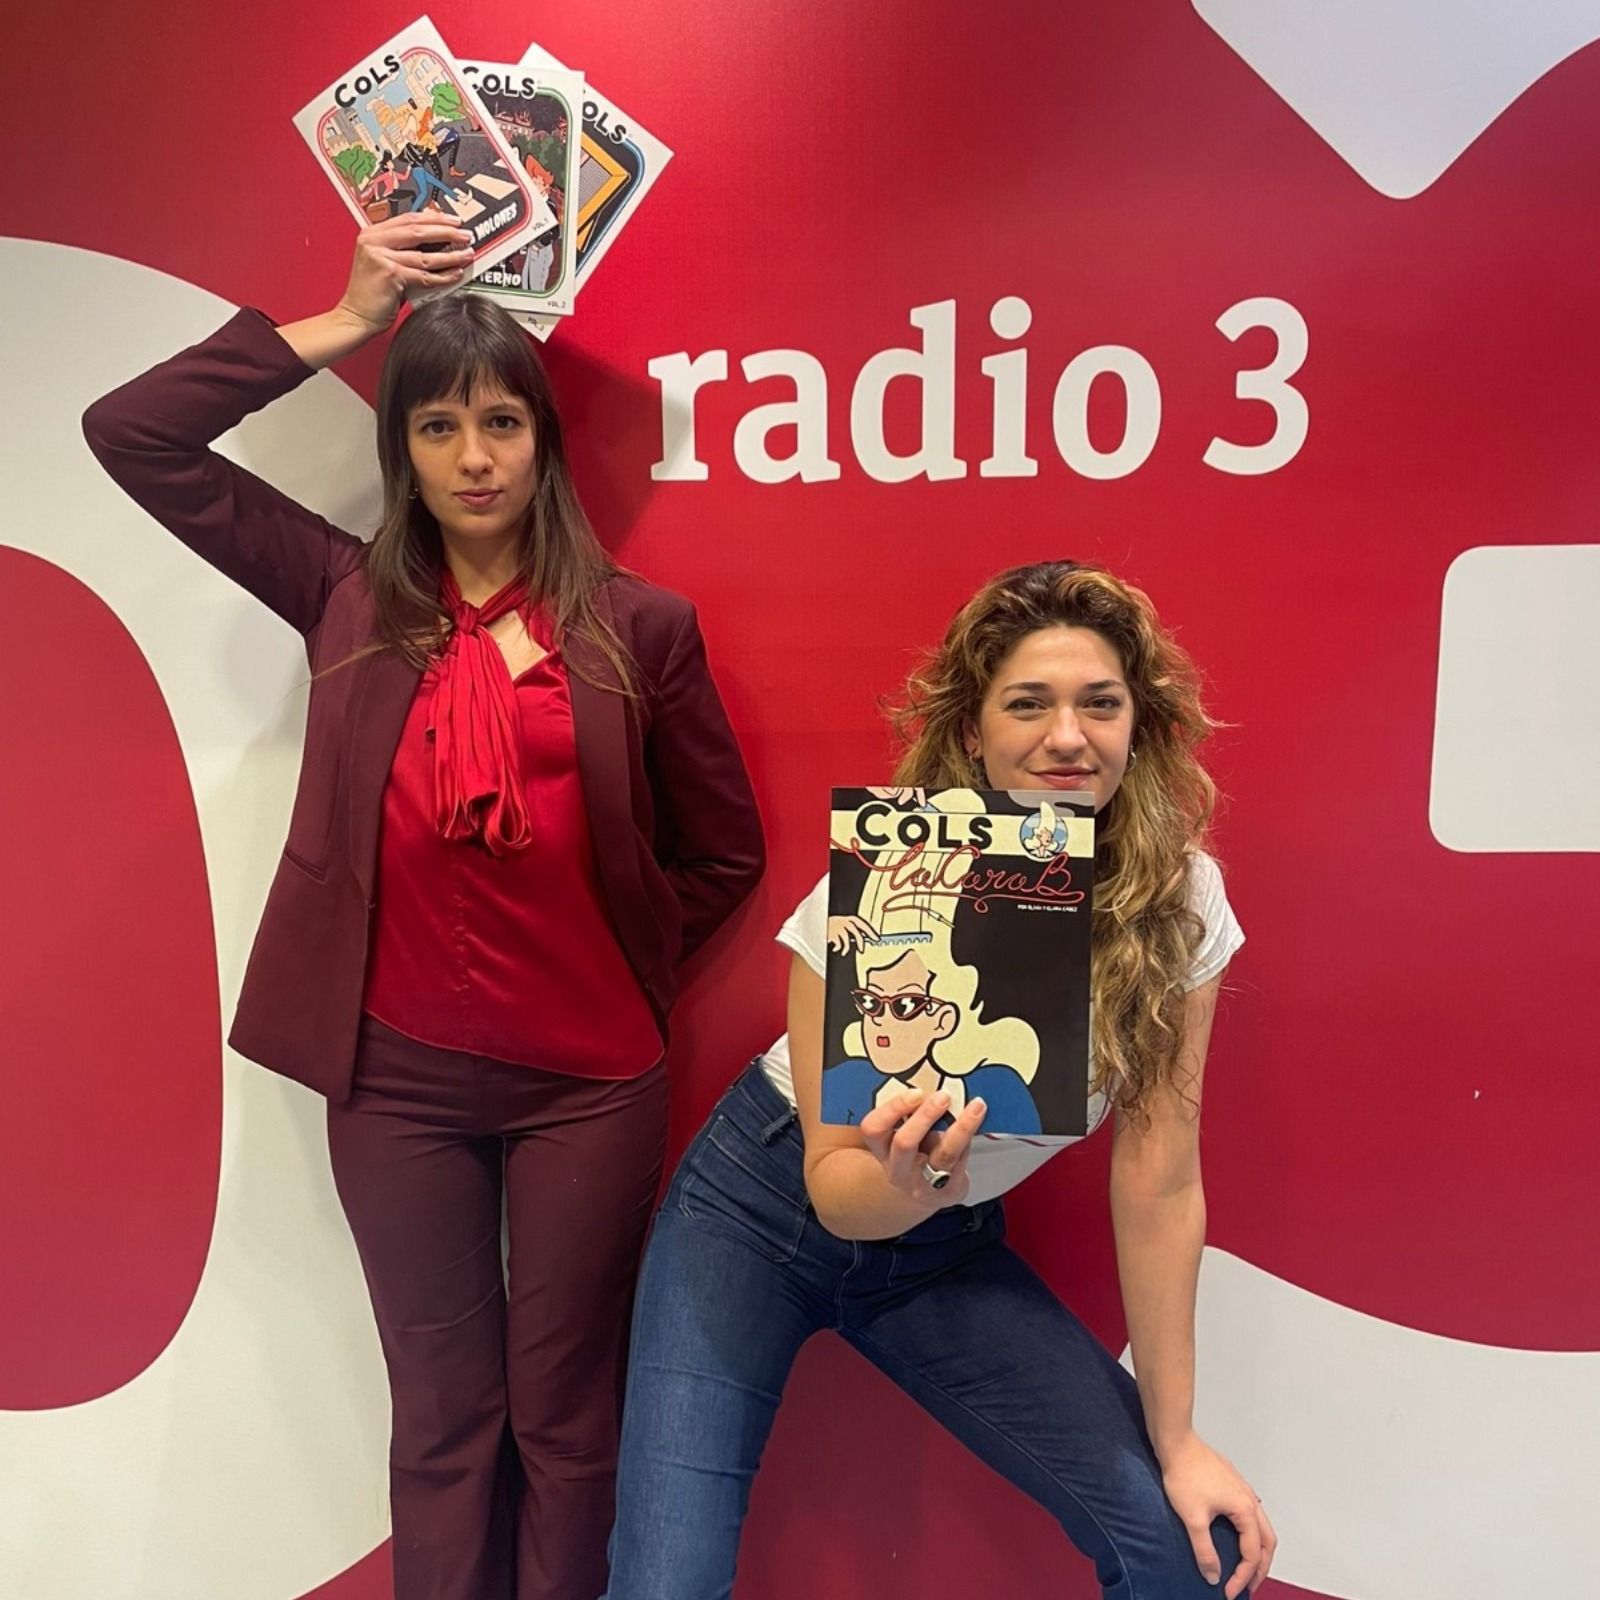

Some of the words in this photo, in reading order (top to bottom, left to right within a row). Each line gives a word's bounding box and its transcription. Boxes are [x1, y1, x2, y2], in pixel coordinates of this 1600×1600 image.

[334, 54, 400, 109] COLS
[582, 98, 627, 142] OLS
[648, 297, 1161, 483] radio
[1203, 297, 1309, 476] 3
[856, 803, 993, 852] COLS
